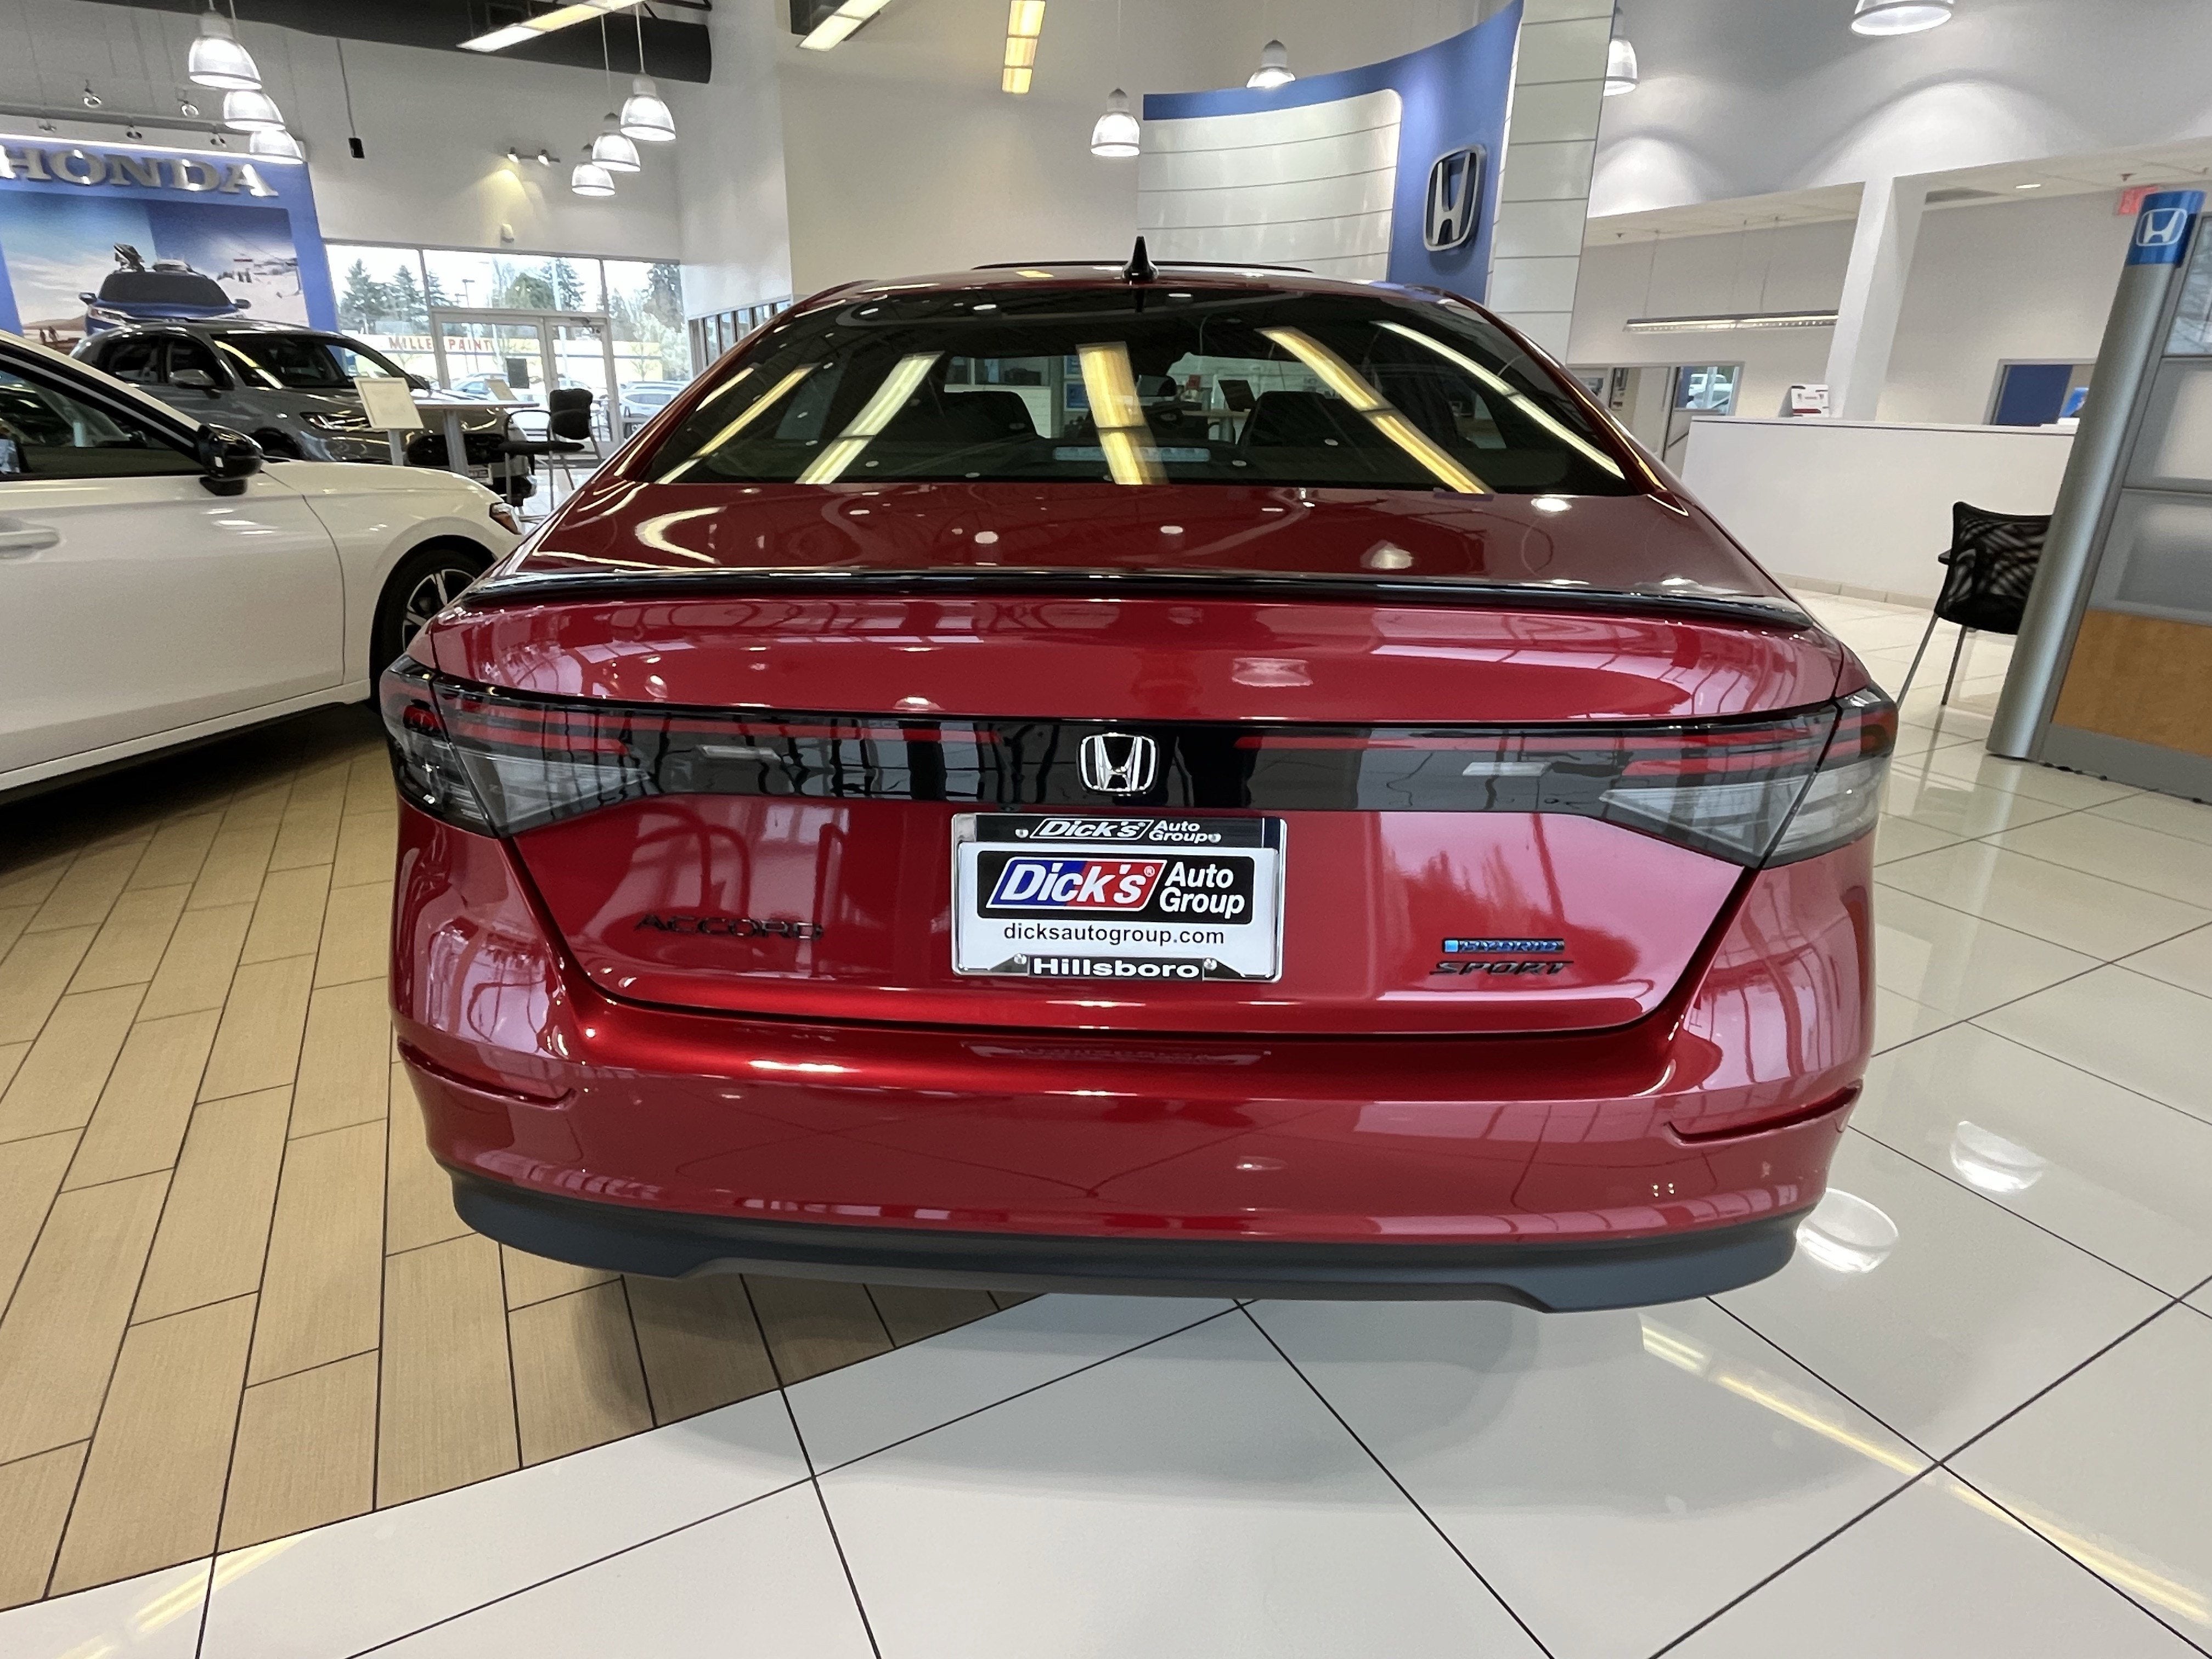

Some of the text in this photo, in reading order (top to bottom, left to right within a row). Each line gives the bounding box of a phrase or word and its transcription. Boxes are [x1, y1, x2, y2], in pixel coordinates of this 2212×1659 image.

[0, 144, 279, 198] HONDA
[388, 337, 490, 351] MILLE PAINT
[1039, 820, 1140, 837] Dick's
[1154, 820, 1200, 831] Auto
[1149, 830, 1207, 844] Group
[1164, 861, 1234, 888] Auto
[1159, 887, 1245, 919] Group
[633, 914, 823, 940] ACCORD
[1003, 923, 1224, 947] dicksautogroup.com
[1032, 957, 1200, 978] Hillsboro
[1429, 960, 1574, 975] SPORT
